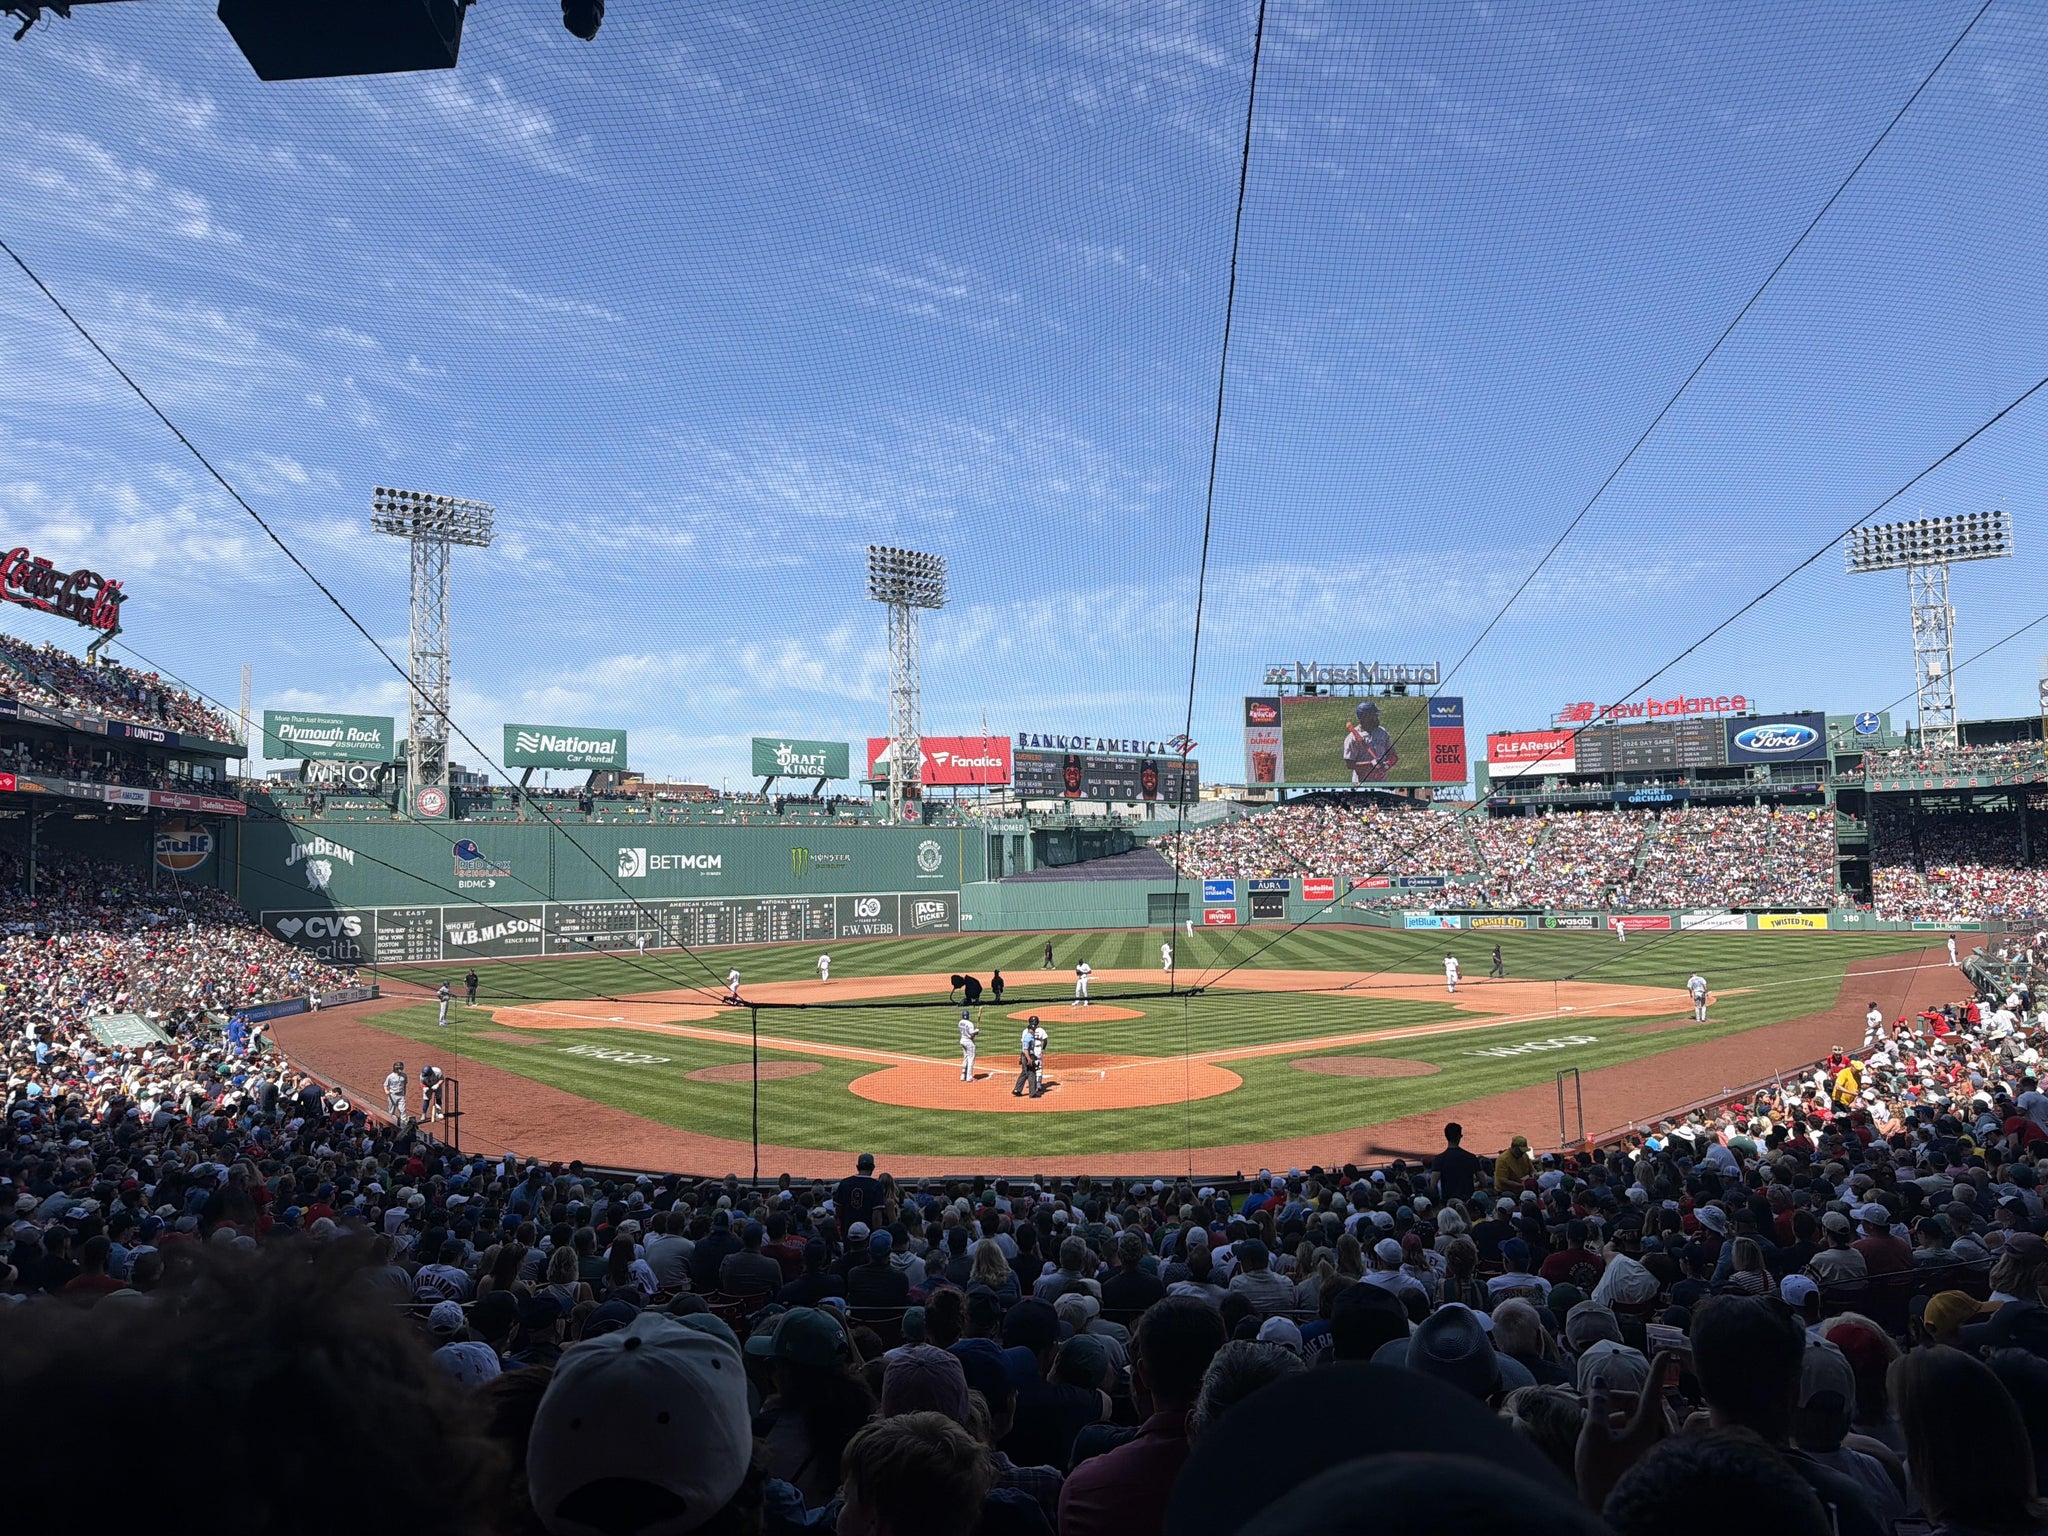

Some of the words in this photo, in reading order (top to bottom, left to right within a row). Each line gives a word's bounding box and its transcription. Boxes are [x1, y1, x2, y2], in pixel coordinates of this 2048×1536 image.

[0, 547, 123, 629] Coca-Cola
[1295, 661, 1440, 683] MassMutual
[1600, 702, 1644, 719] new
[1647, 694, 1747, 717] balance
[134, 727, 165, 742] UNITED
[279, 724, 344, 741] Plymouth
[346, 727, 381, 742] Rock
[1751, 729, 1800, 748] Ford
[335, 741, 382, 749] assurance
[540, 735, 617, 754] National
[1019, 732, 1068, 750] BANK
[1070, 736, 1092, 750] OF
[1096, 738, 1167, 755] AMERICA
[1435, 744, 1459, 754] SEAT
[1496, 739, 1565, 753] CLEAResult
[567, 754, 582, 762] Car
[776, 753, 826, 766] DRAFT
[951, 755, 1002, 767] Fanatics
[1434, 754, 1461, 764] GEEK
[307, 764, 402, 783] WHOO
[783, 764, 825, 775] KINGS
[1892, 781, 1900, 790] 4
[1909, 780, 1914, 790] 1
[1942, 778, 1958, 789] 27
[122, 791, 144, 801] AMAZING
[1092, 786, 1097, 796] 0
[1109, 787, 1115, 796] 0
[1126, 788, 1132, 797] 0
[1628, 794, 1673, 802] ORCHARD
[202, 801, 224, 810] Safelite
[156, 834, 209, 852] Gulf
[285, 842, 314, 867] JIM
[314, 836, 355, 867] BEAM
[650, 855, 722, 870] BETMGM
[810, 854, 851, 862] MONSTER
[460, 861, 483, 869] RED
[487, 860, 511, 869] SOX
[458, 880, 487, 888] BIDMC
[854, 898, 881, 917] 160
[918, 901, 945, 914] ACE
[919, 911, 945, 923] TICKET
[1408, 917, 1436, 927] jetBlue
[1472, 917, 1506, 927] GRANITE
[1507, 917, 1526, 928] CITY
[1557, 916, 1592, 925] wasabi
[1770, 918, 1800, 928] TWISTED
[1801, 918, 1814, 928] TEA
[305, 916, 362, 938] CVS
[450, 918, 541, 945] W.B.MASON
[842, 925, 860, 935] F.W.
[863, 924, 893, 935] WEBB
[293, 940, 362, 960] ealth
[1462, 1035, 1599, 1057] WHOOP
